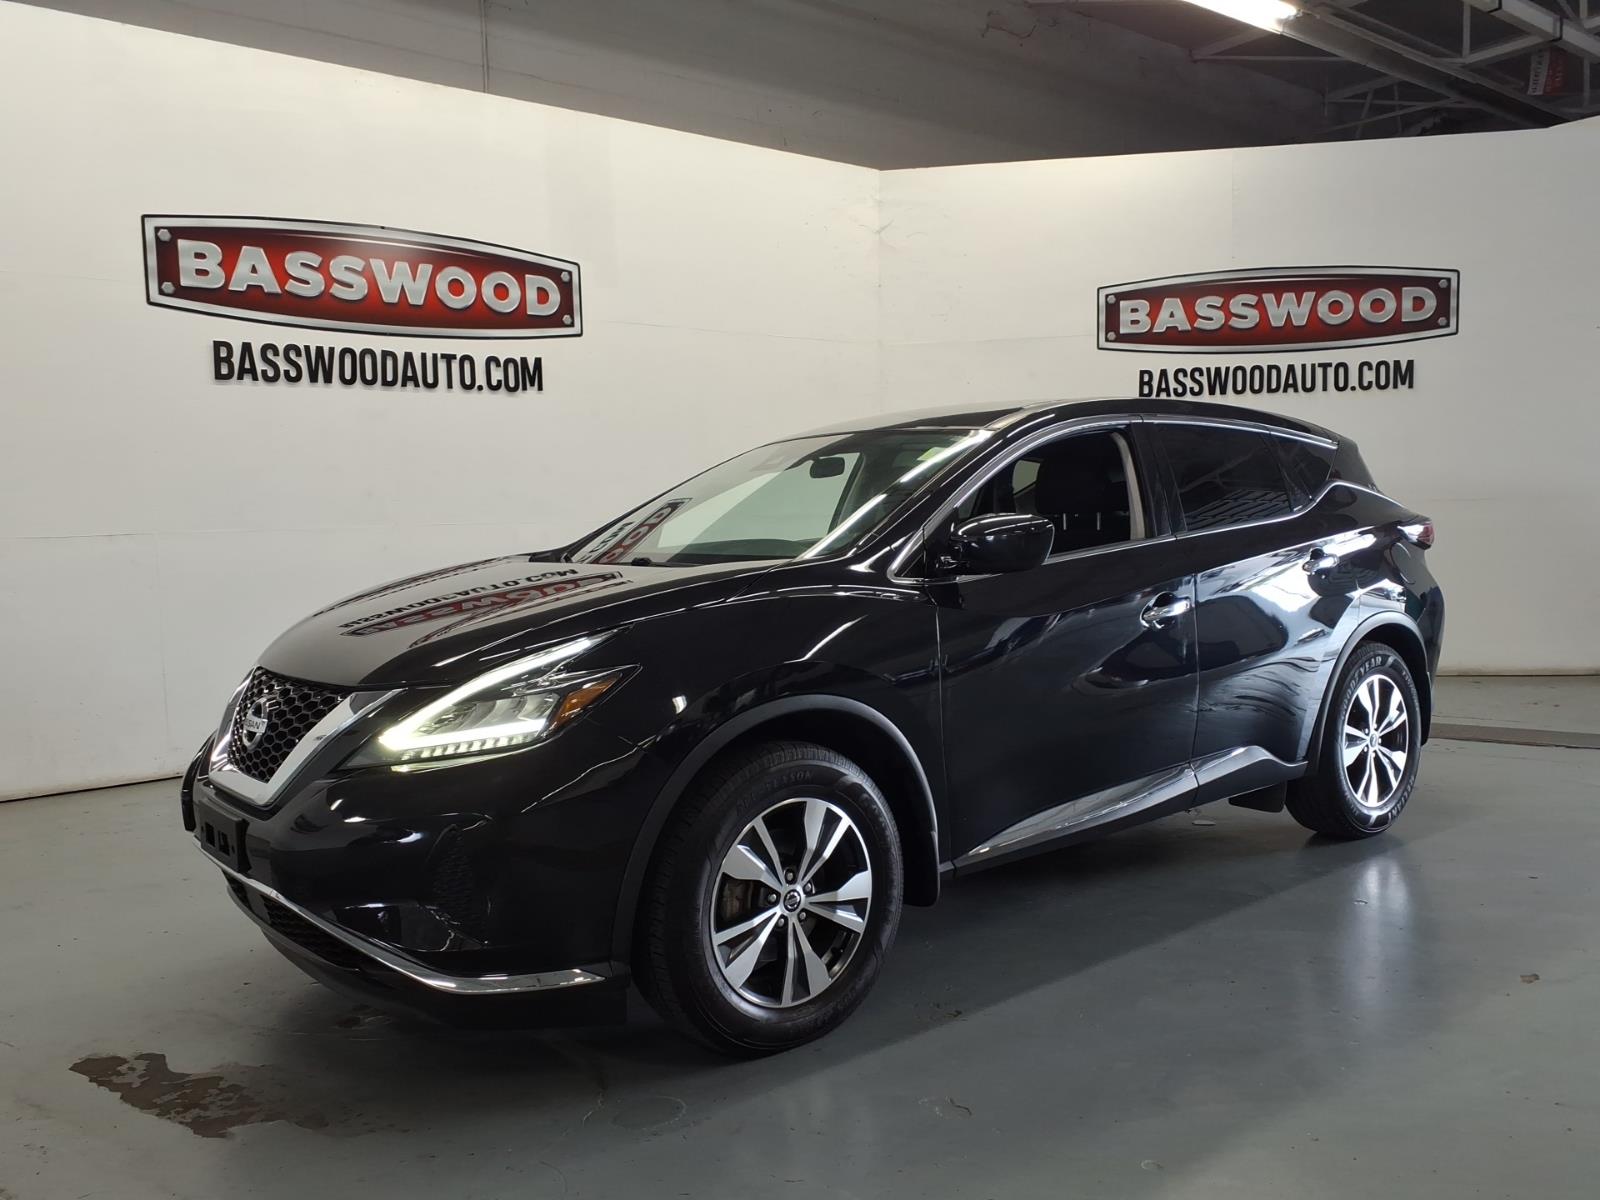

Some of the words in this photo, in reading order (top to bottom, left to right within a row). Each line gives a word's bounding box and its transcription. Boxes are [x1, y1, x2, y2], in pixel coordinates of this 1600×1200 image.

[177, 238, 561, 316] BASSWOOD
[1119, 286, 1437, 335] BASSWOOD
[212, 340, 544, 392] BASSWOODAUTO.COM
[1138, 359, 1415, 398] BASSWOODAUTO.COM
